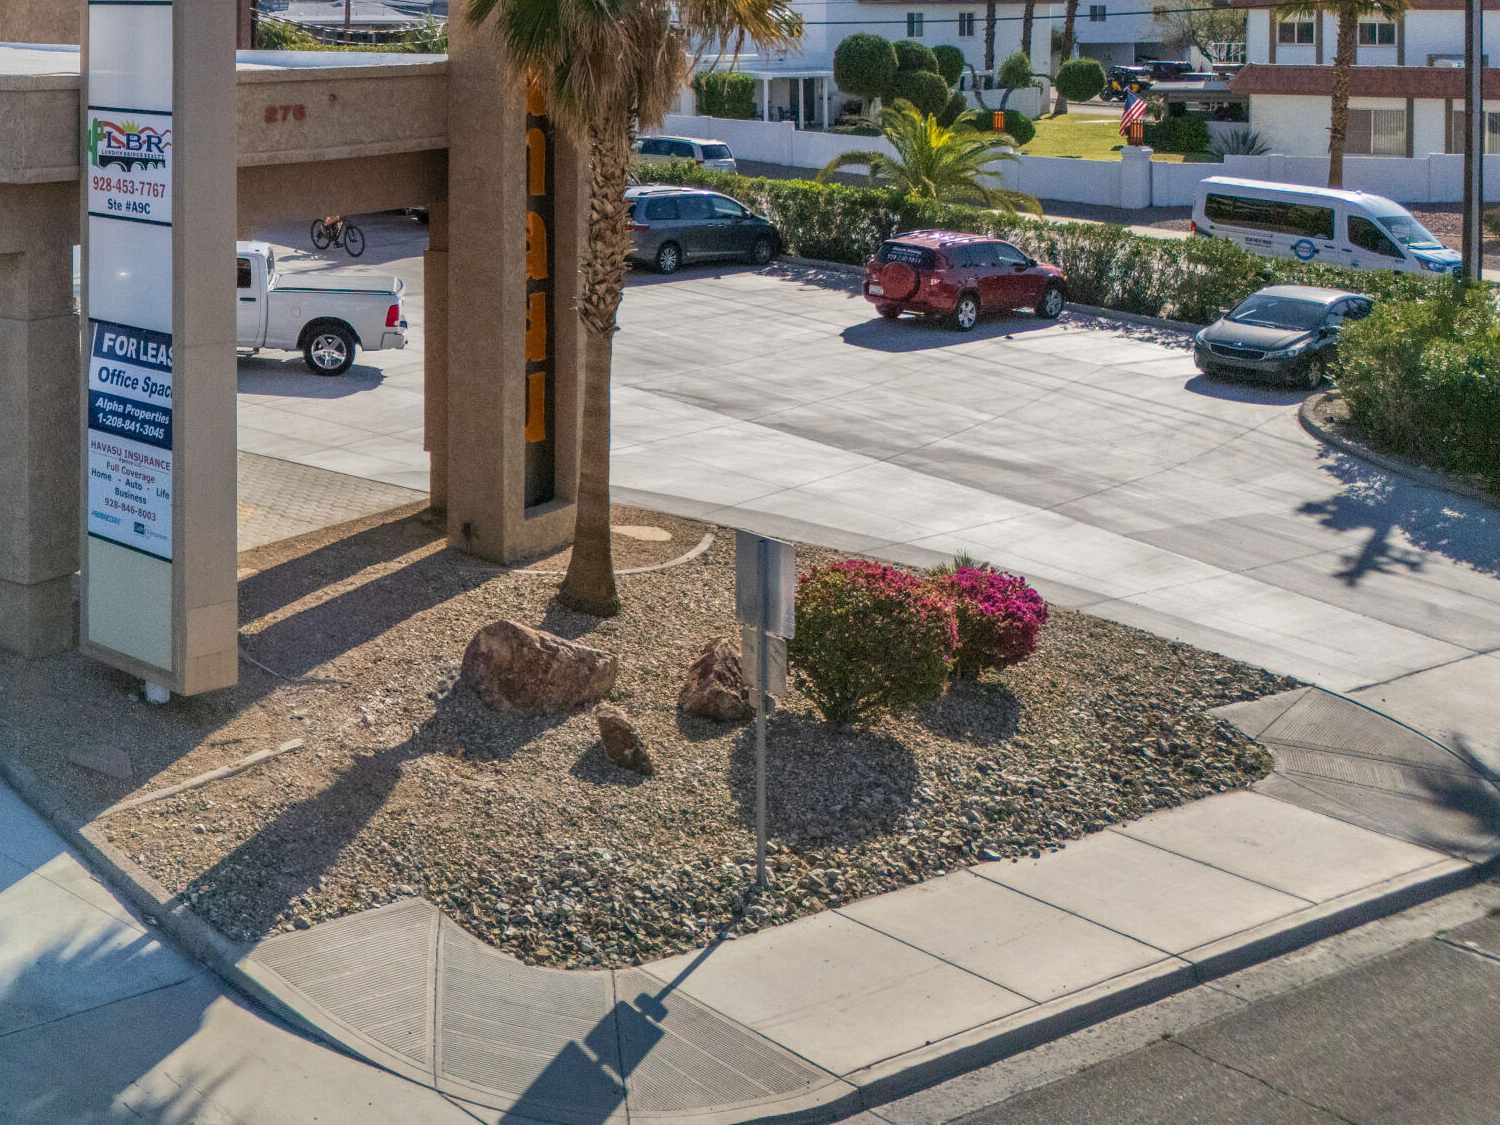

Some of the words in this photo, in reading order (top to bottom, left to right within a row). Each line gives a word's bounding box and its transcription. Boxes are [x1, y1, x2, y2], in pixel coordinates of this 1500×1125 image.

[264, 103, 306, 125] 276
[105, 131, 164, 153] LBR
[93, 175, 166, 198] 928-453-7767
[107, 198, 122, 210] Ste
[125, 200, 151, 214] #A9C
[102, 332, 137, 359] FOR
[98, 366, 139, 390] Office
[141, 376, 172, 398] Spac
[95, 397, 123, 414] Alpha
[125, 404, 169, 425] Properties
[97, 412, 165, 439] 1-208-841-3045
[91, 440, 122, 456] HAVASU
[124, 449, 171, 471] INSURANCE
[91, 468, 112, 481] Home
[125, 478, 143, 491] Auto
[156, 487, 170, 500] Life
[106, 461, 120, 473] Full
[121, 466, 156, 484] Coverage
[114, 487, 147, 505] Business
[104, 497, 157, 522] 928-846-8003
